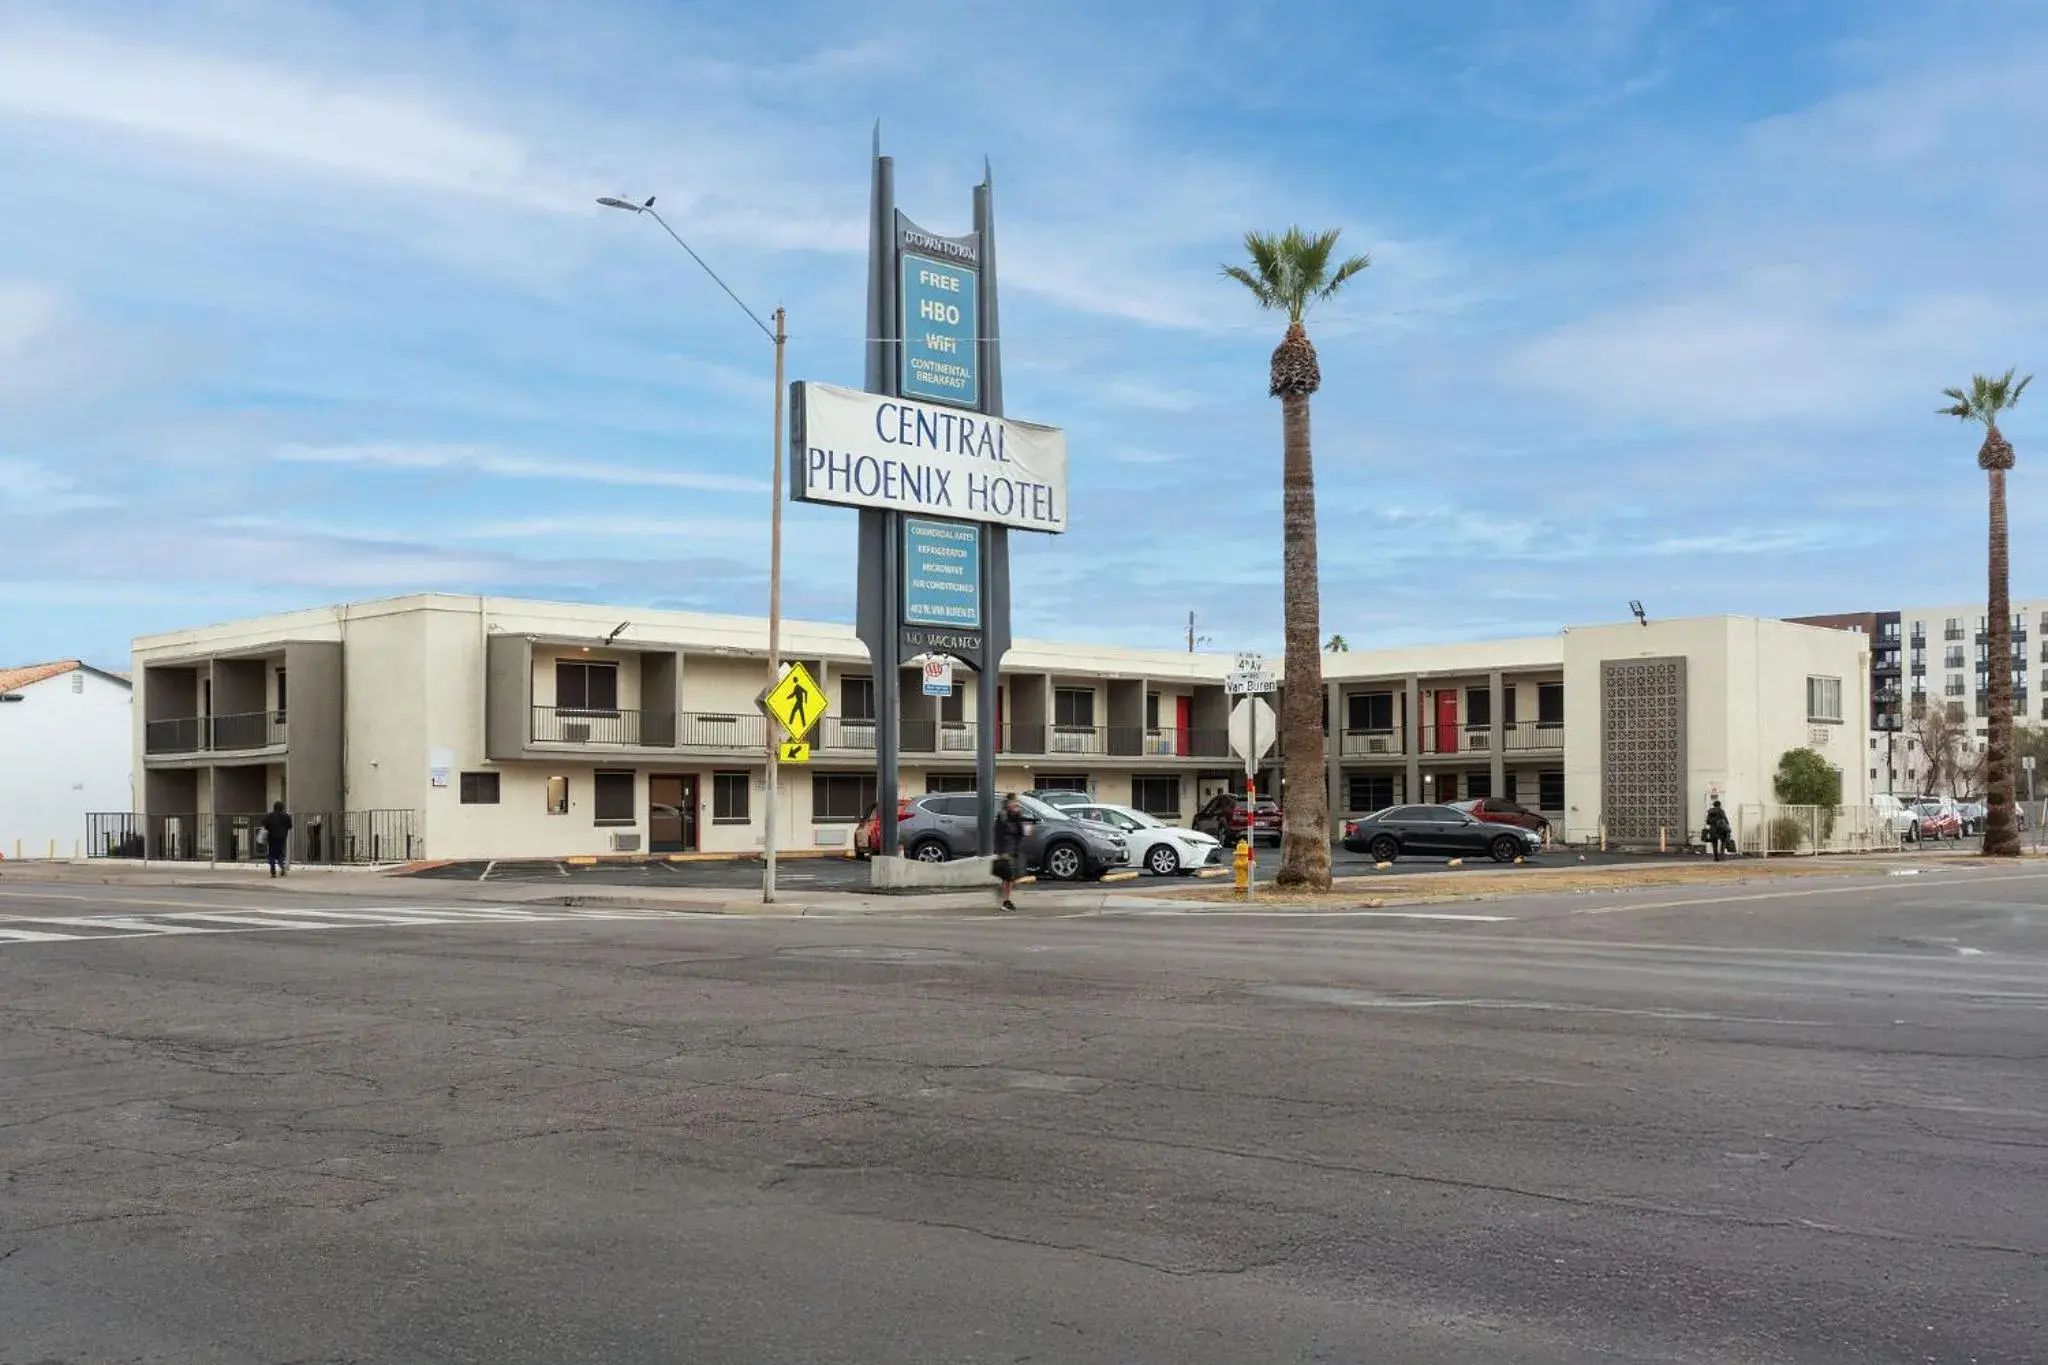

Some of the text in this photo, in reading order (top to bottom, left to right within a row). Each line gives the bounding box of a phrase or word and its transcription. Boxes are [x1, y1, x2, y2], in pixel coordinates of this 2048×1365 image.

[905, 230, 976, 260] DOWNTOWN
[920, 270, 960, 292] FREE
[921, 299, 960, 325] HBO
[911, 358, 971, 378] CONTINENTAL
[916, 371, 966, 389] BREAKFAST
[876, 402, 1010, 463] CENTRAL
[808, 447, 1060, 523] PHOENIX HOTEL
[923, 563, 963, 575] MICROWAVE
[906, 632, 981, 649] NO VACANCY
[1226, 680, 1276, 692] Van Buren
